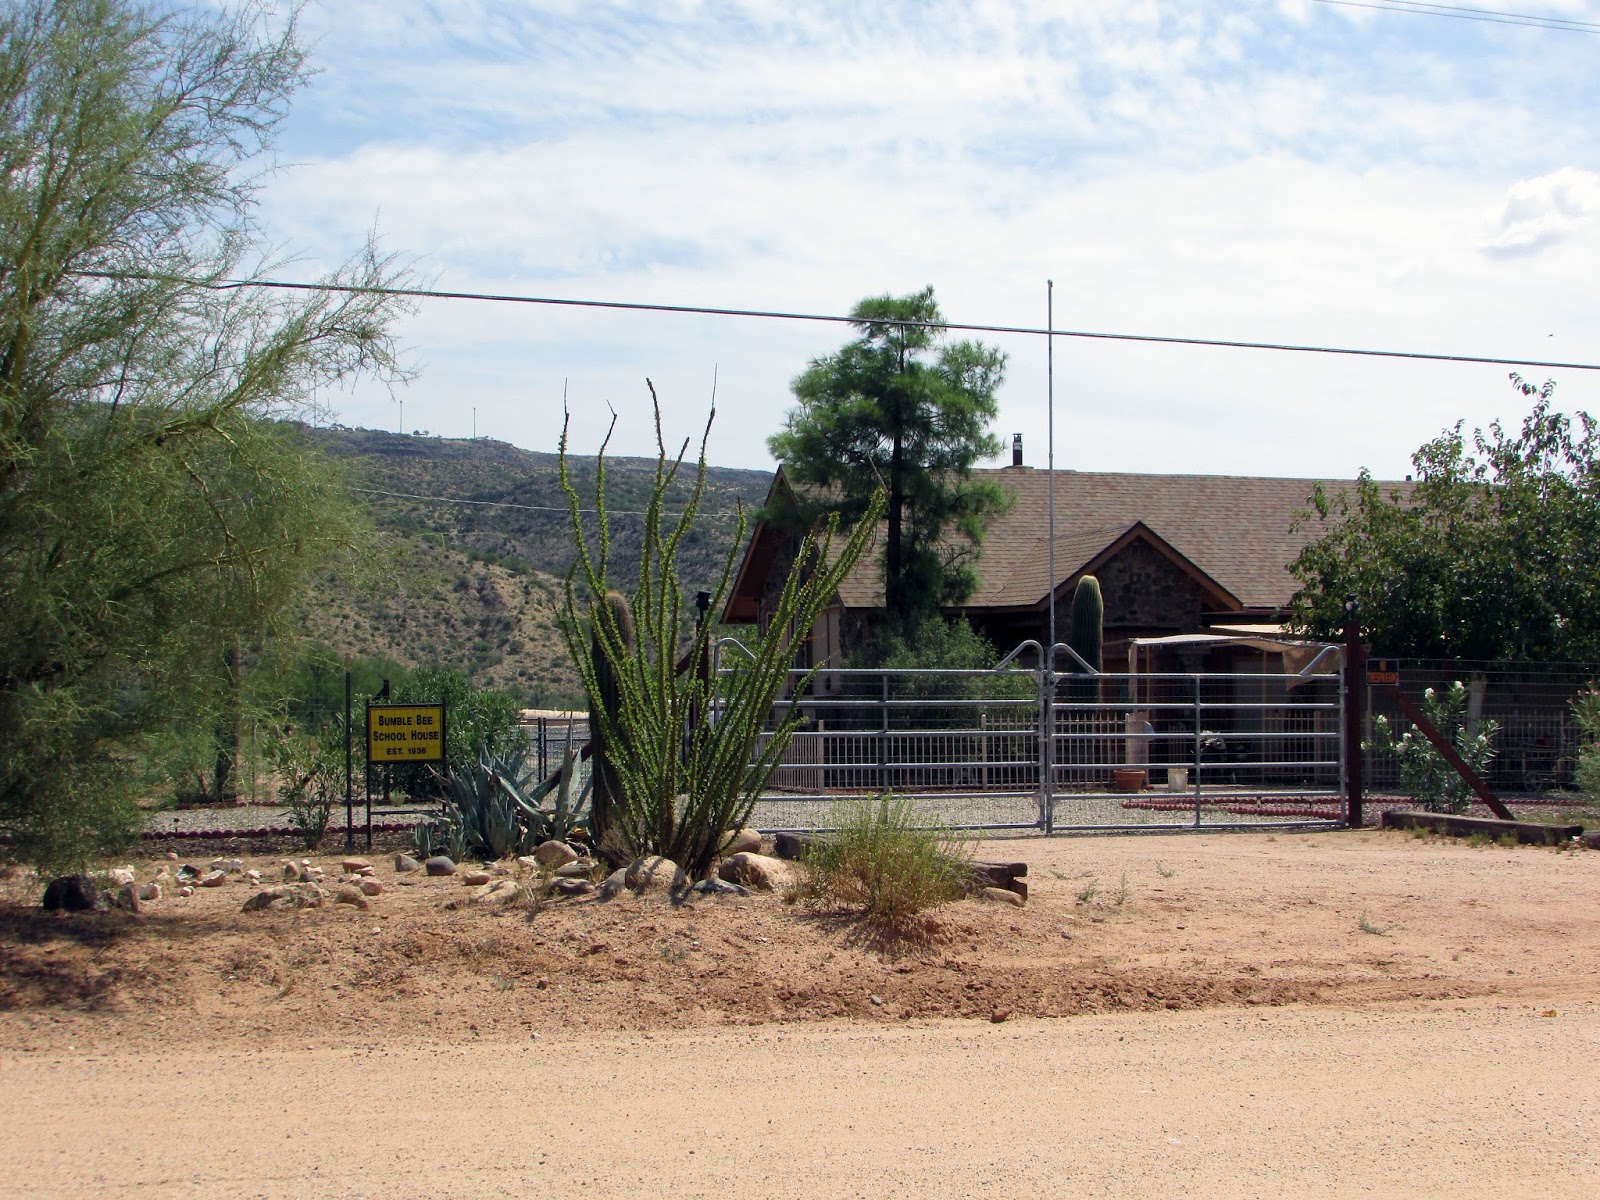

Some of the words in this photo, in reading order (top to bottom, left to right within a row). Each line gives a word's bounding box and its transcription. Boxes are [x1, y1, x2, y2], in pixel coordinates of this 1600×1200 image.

[378, 716, 412, 726] BUMBLE
[416, 715, 433, 725] BEE
[373, 731, 407, 741] SCHOOL
[411, 730, 439, 740] HOUSE
